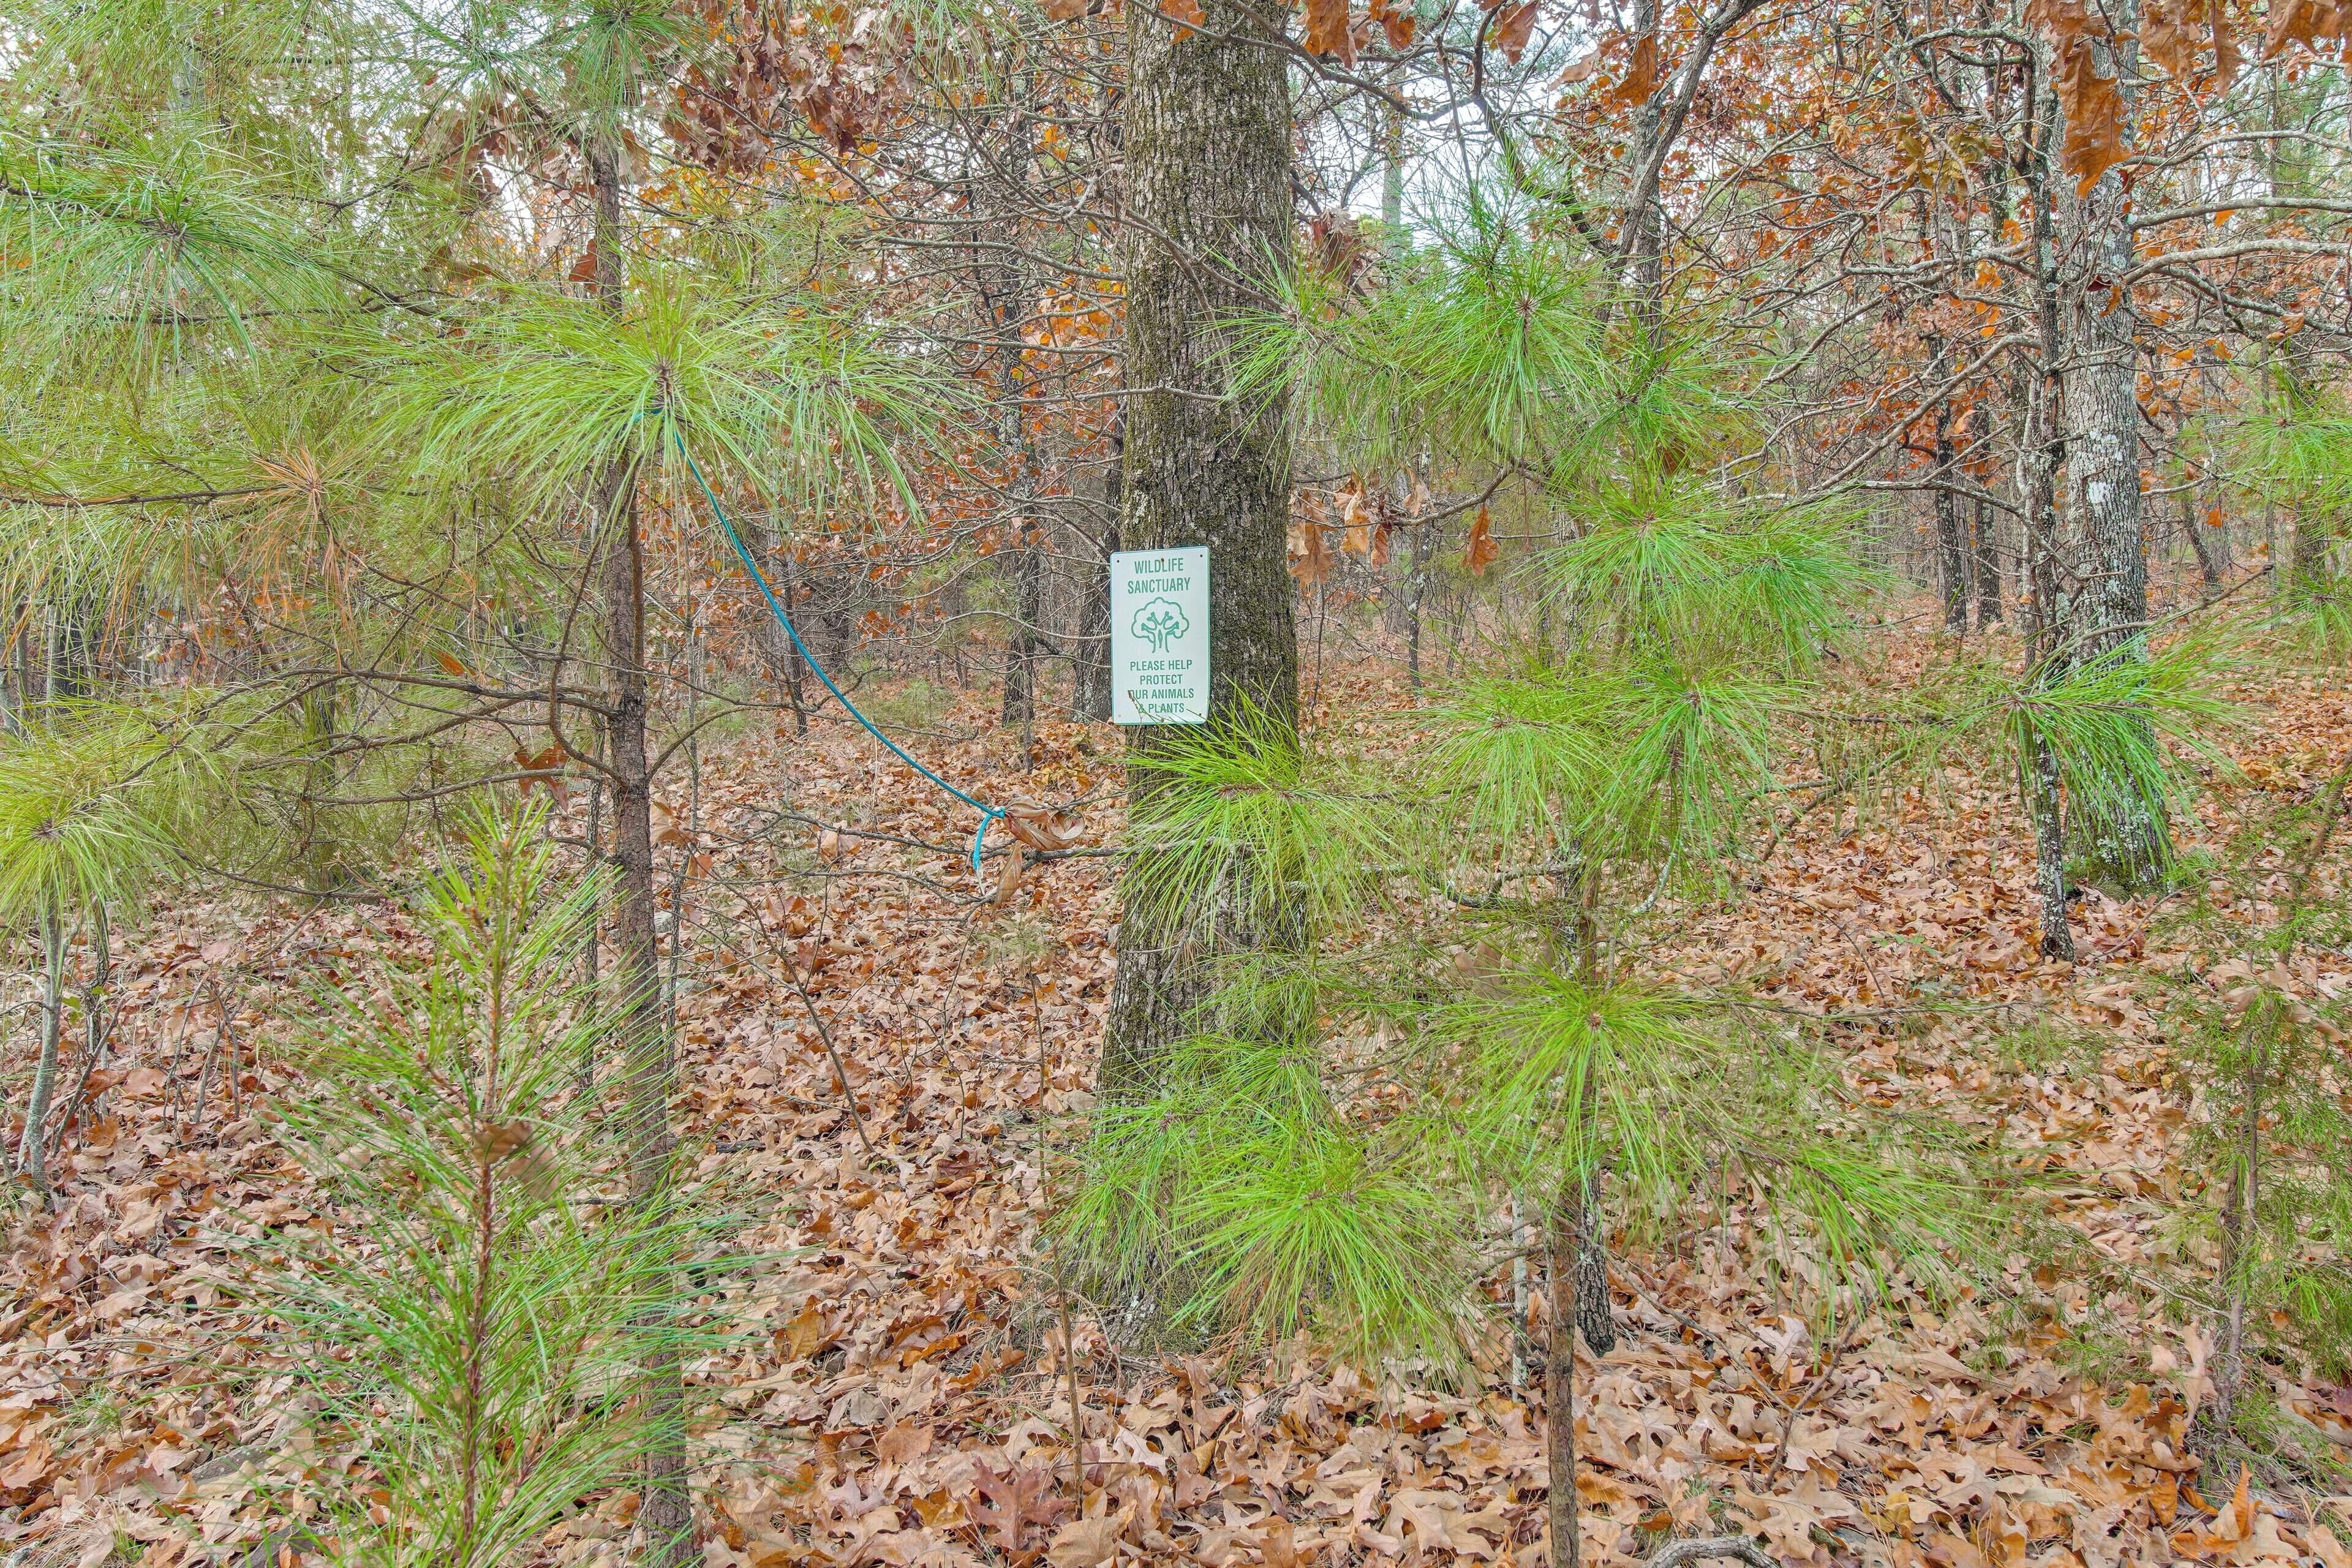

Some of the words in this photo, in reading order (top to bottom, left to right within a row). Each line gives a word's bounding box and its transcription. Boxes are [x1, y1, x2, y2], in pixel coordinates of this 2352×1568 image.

[1134, 558, 1183, 574] WILDLIFE
[1128, 577, 1191, 594] SANCTUARY
[1130, 661, 1165, 671] PLEASE
[1169, 660, 1192, 670] HELP
[1140, 674, 1183, 685] PROTECT
[1152, 688, 1194, 699] ANIMALS
[1148, 703, 1185, 714] PLANTS
